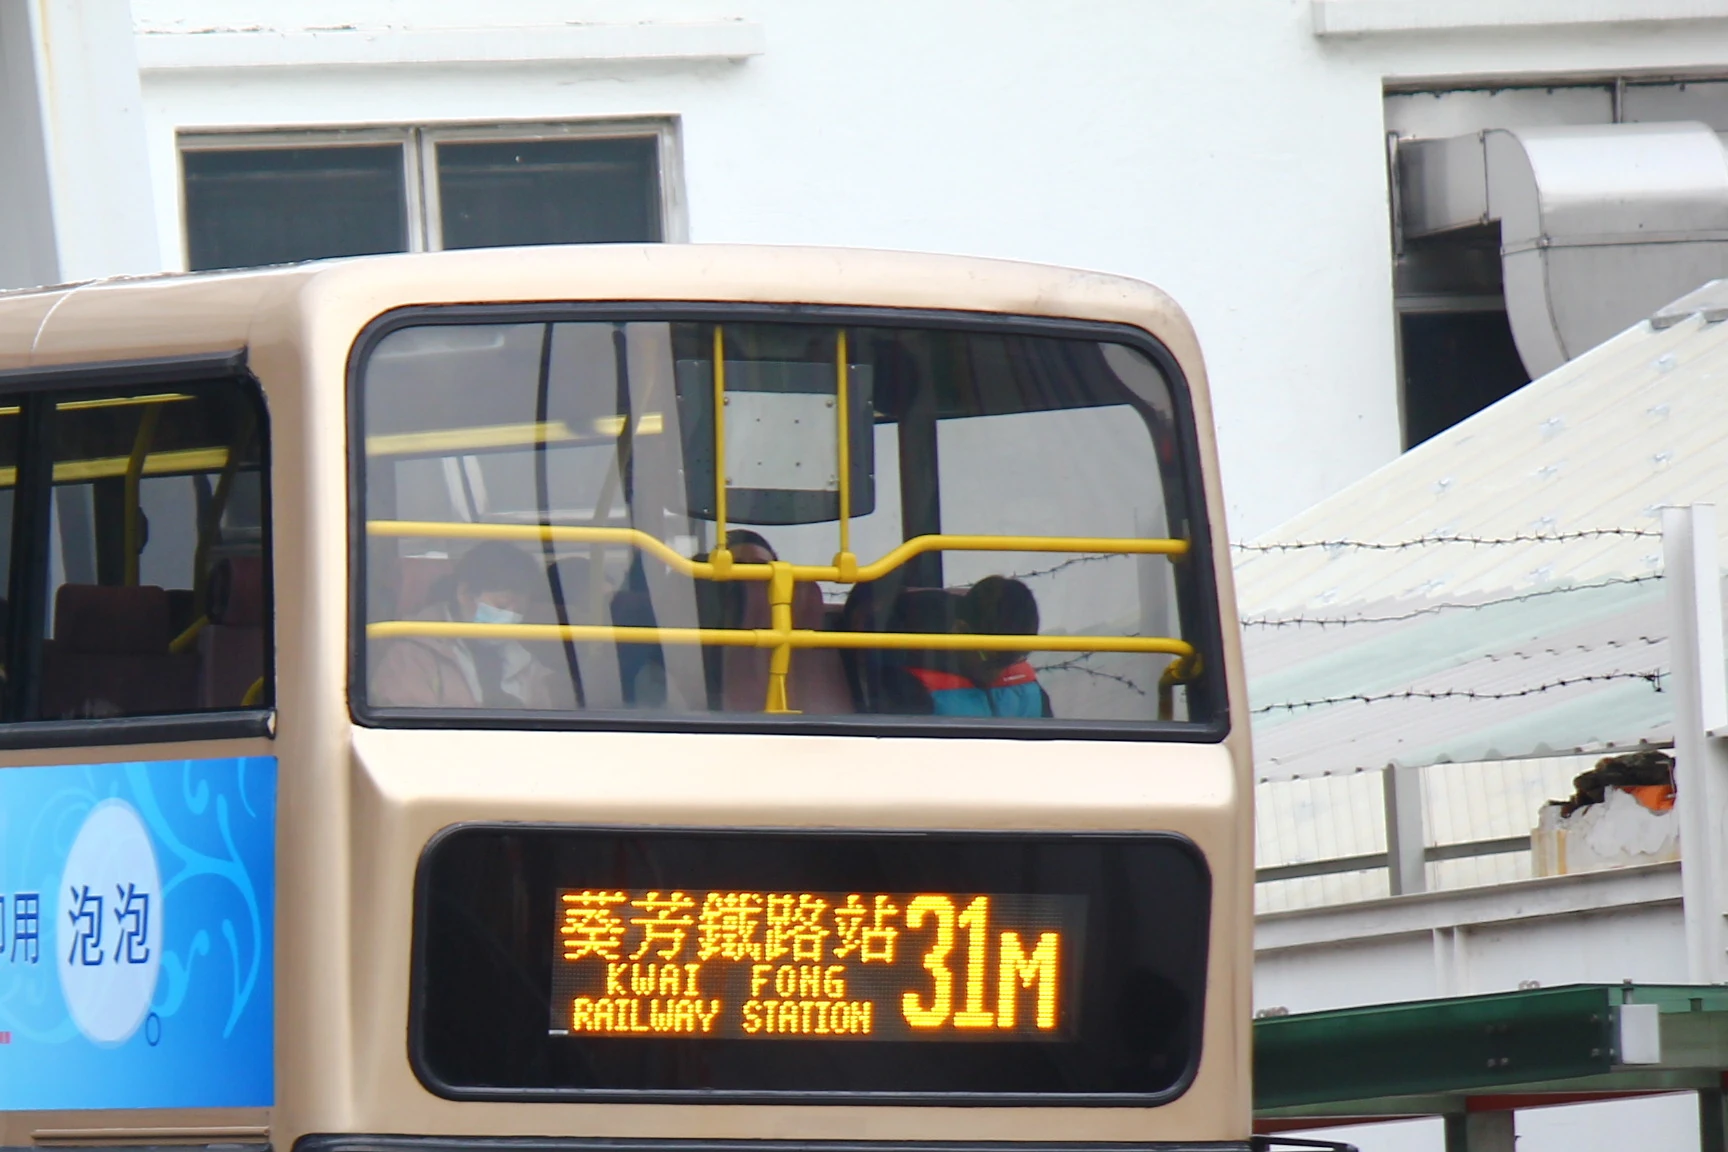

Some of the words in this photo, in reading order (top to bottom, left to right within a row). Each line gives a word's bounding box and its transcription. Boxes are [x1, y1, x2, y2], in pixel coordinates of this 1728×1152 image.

[67, 882, 151, 967] 泡泡
[560, 890, 899, 964] 葵芳鐵路站
[607, 963, 701, 997] KWAI
[751, 964, 847, 998] FONG
[902, 895, 1062, 1029] 31M
[573, 998, 721, 1032] RAILWAY
[741, 1000, 872, 1034] STATION
